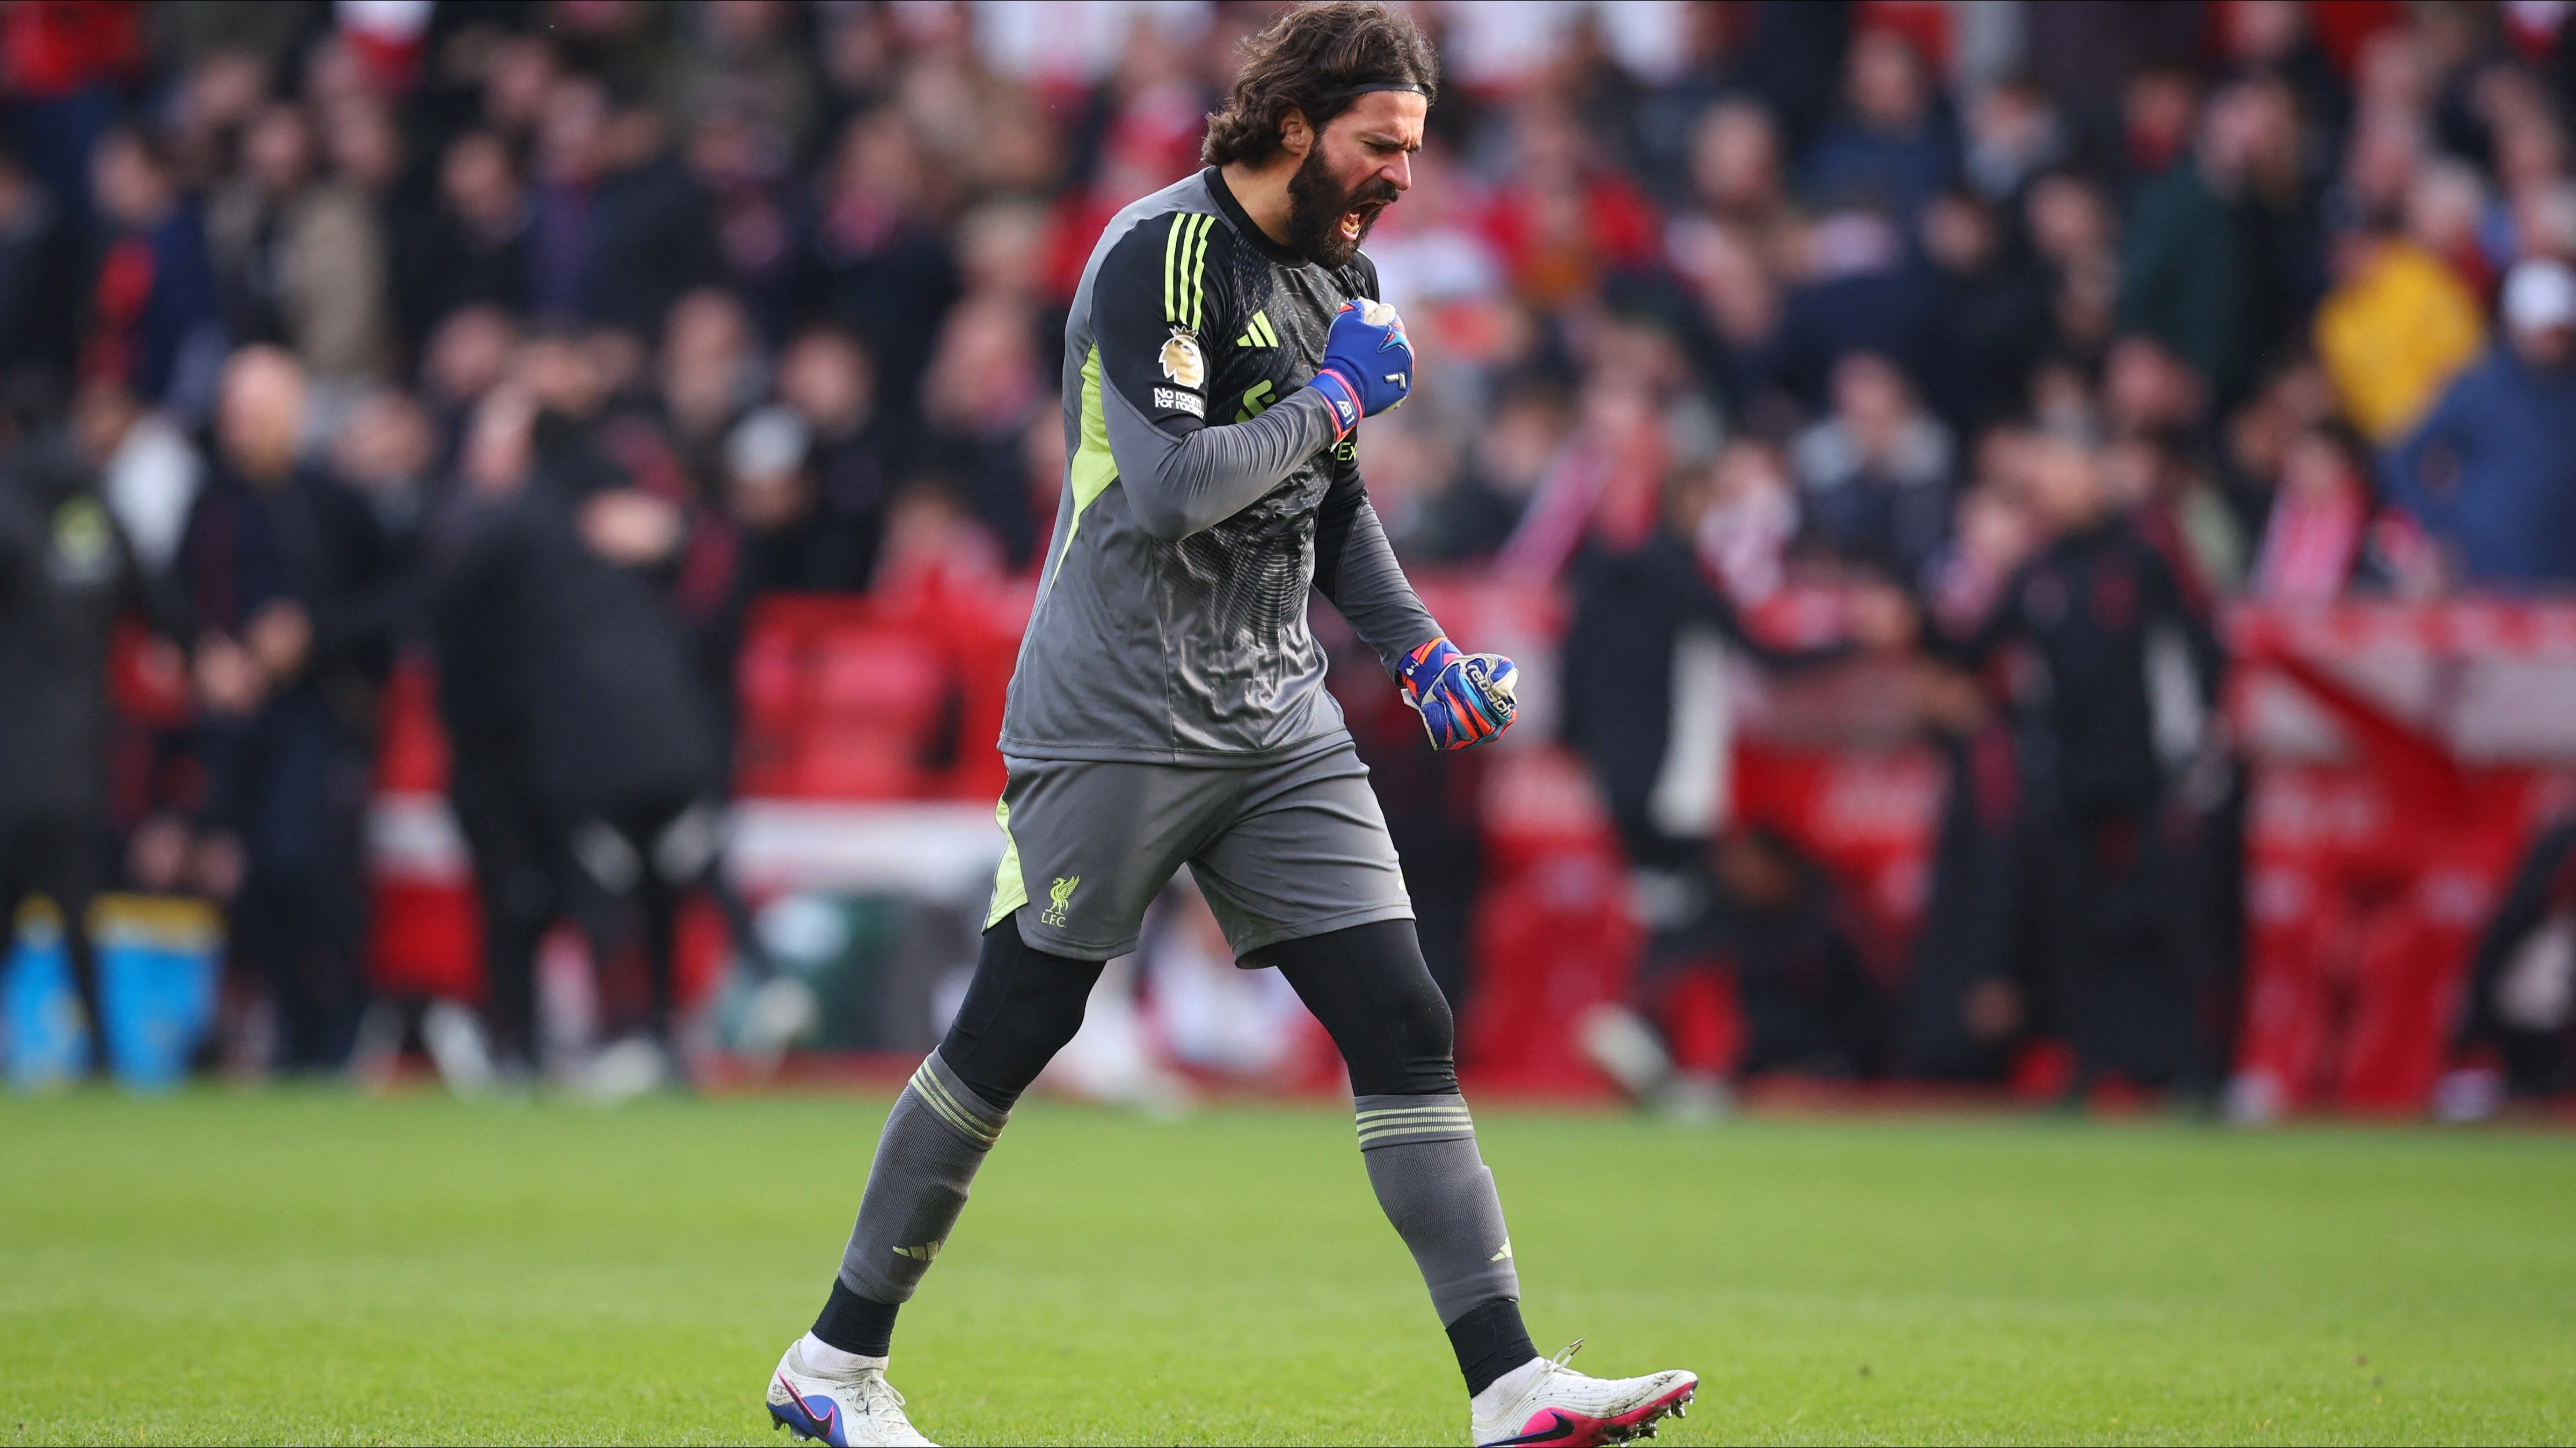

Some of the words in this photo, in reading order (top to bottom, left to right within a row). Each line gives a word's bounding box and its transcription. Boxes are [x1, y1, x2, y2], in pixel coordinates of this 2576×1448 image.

[1154, 387, 1174, 400] No
[1176, 392, 1202, 410] room
[1337, 442, 1357, 461] Ex
[1466, 664, 1512, 716] reusch
[1041, 912, 1067, 928] L.F.C.
